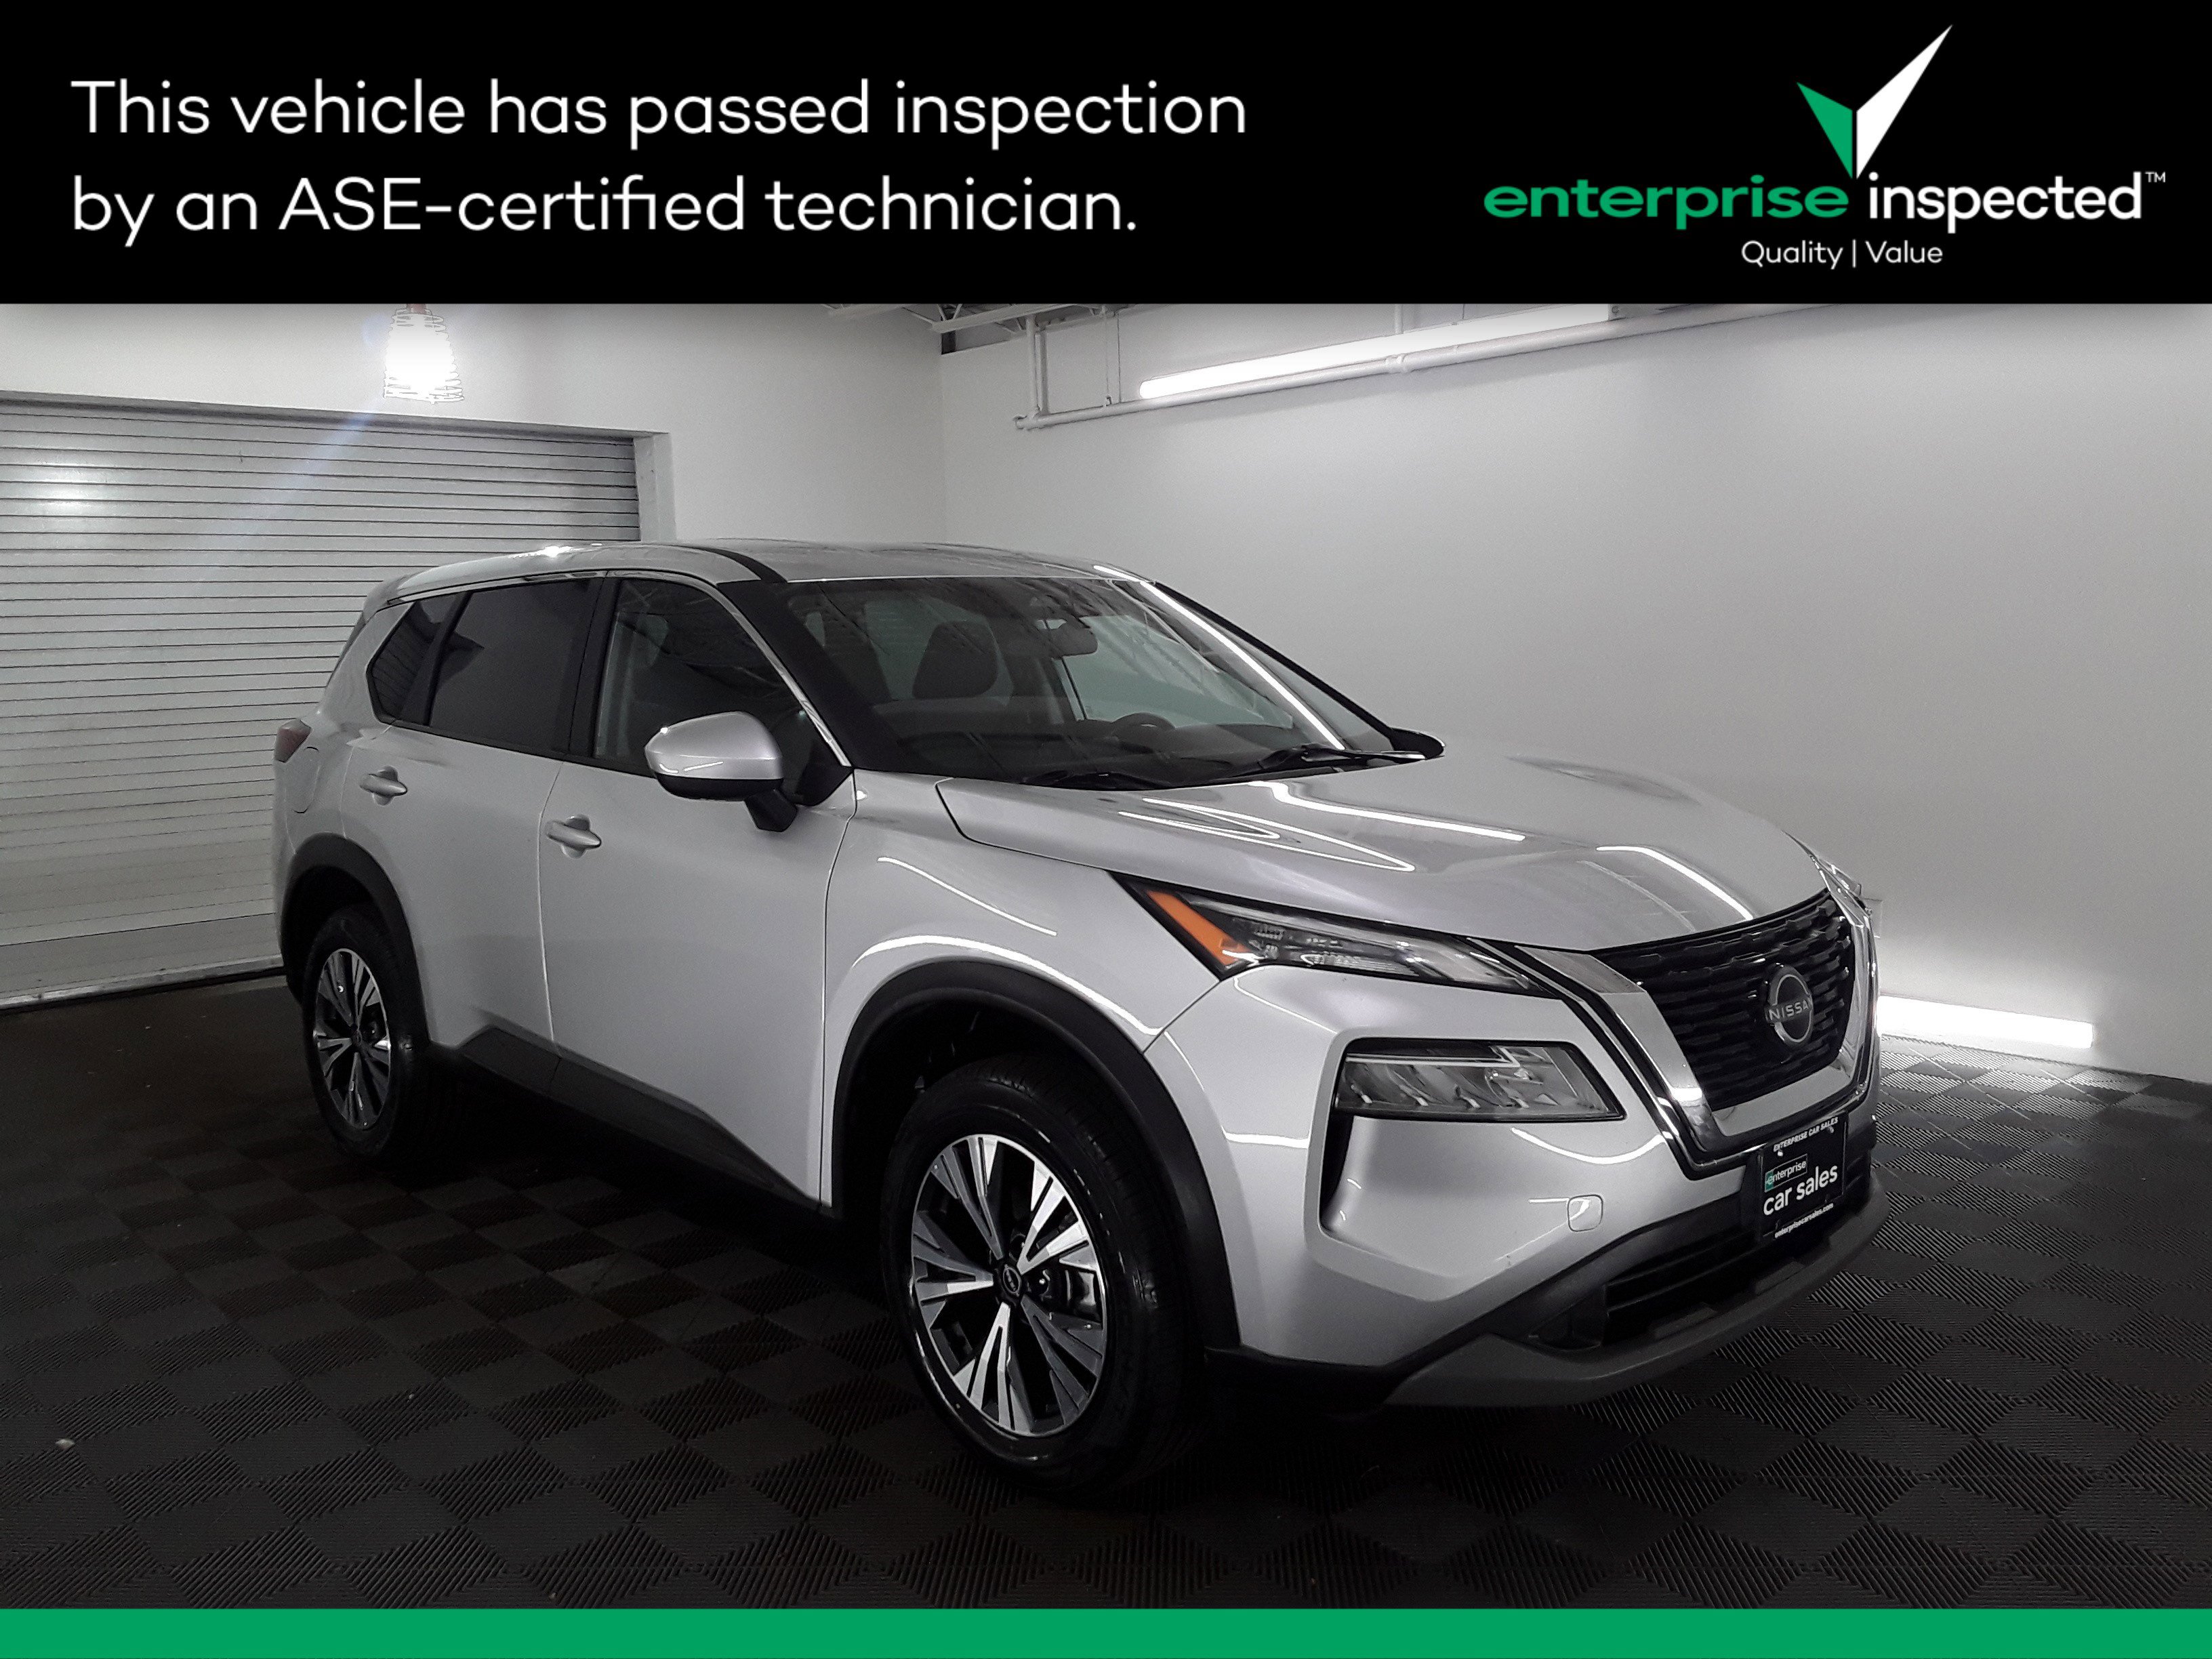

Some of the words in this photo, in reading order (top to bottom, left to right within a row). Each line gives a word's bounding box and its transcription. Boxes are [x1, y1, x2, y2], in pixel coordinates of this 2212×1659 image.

[1773, 1131, 1808, 1152] ENTERPRISE
[1808, 1125, 1820, 1136] CAR
[1820, 1116, 1839, 1130] SALES
[1763, 1187, 1793, 1215] car
[1796, 1165, 1838, 1200] sales
[1765, 1161, 1806, 1185] enterprise
